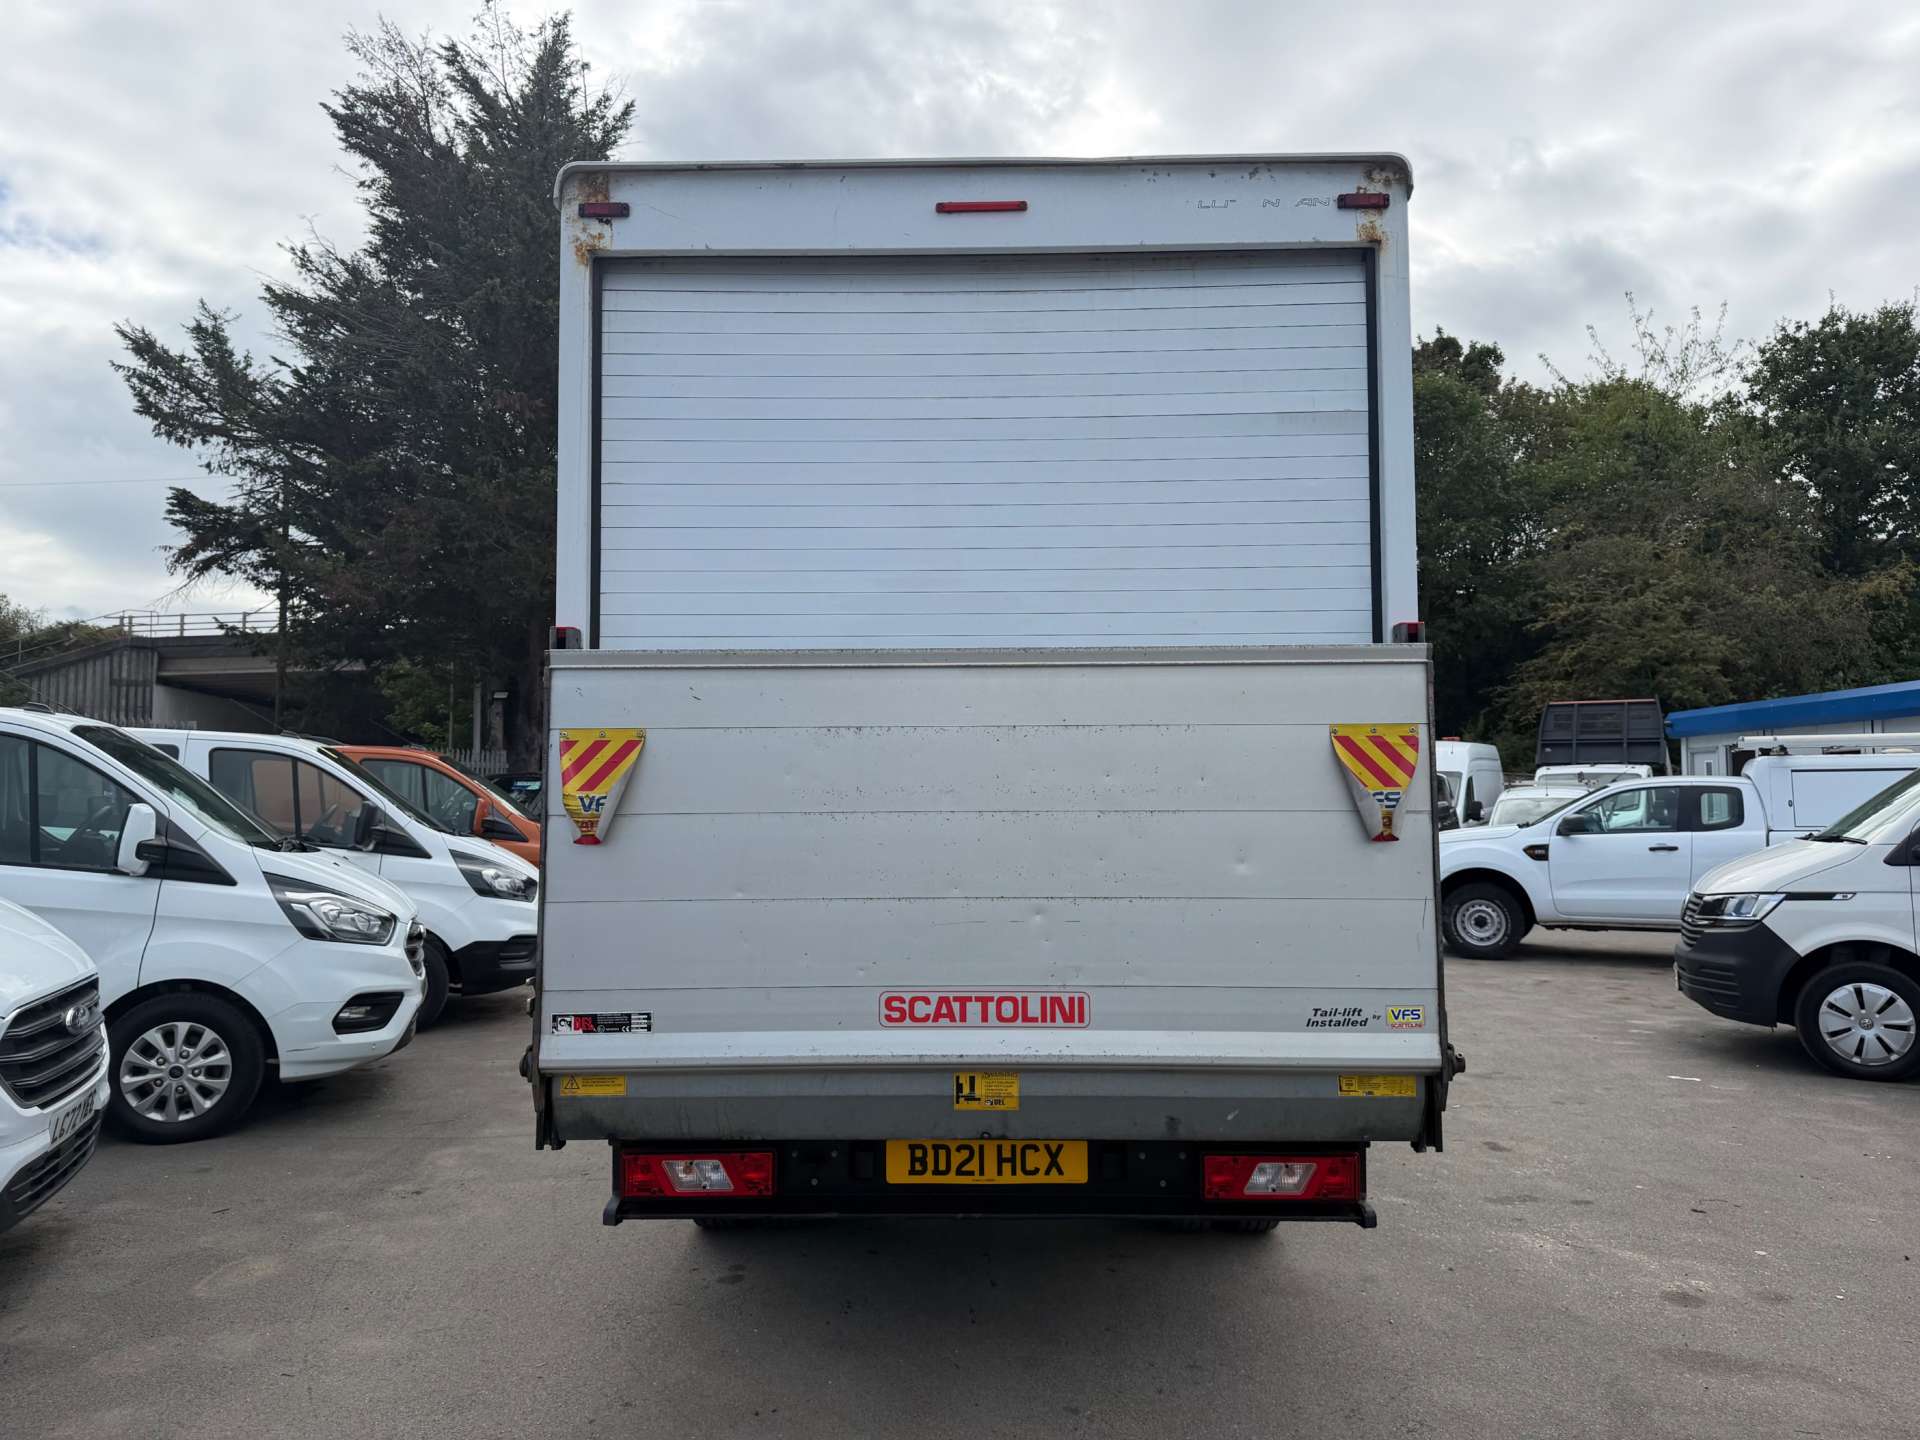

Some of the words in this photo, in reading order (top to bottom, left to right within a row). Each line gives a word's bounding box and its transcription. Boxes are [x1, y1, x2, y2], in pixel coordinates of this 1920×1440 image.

[884, 995, 1085, 1024] SCATTOLINI
[1312, 1007, 1363, 1017] Tail-lift
[1390, 1008, 1421, 1021] VFS
[1306, 1018, 1369, 1028] Installed
[908, 1143, 985, 1177] BD21
[997, 1143, 1065, 1177] HCX
